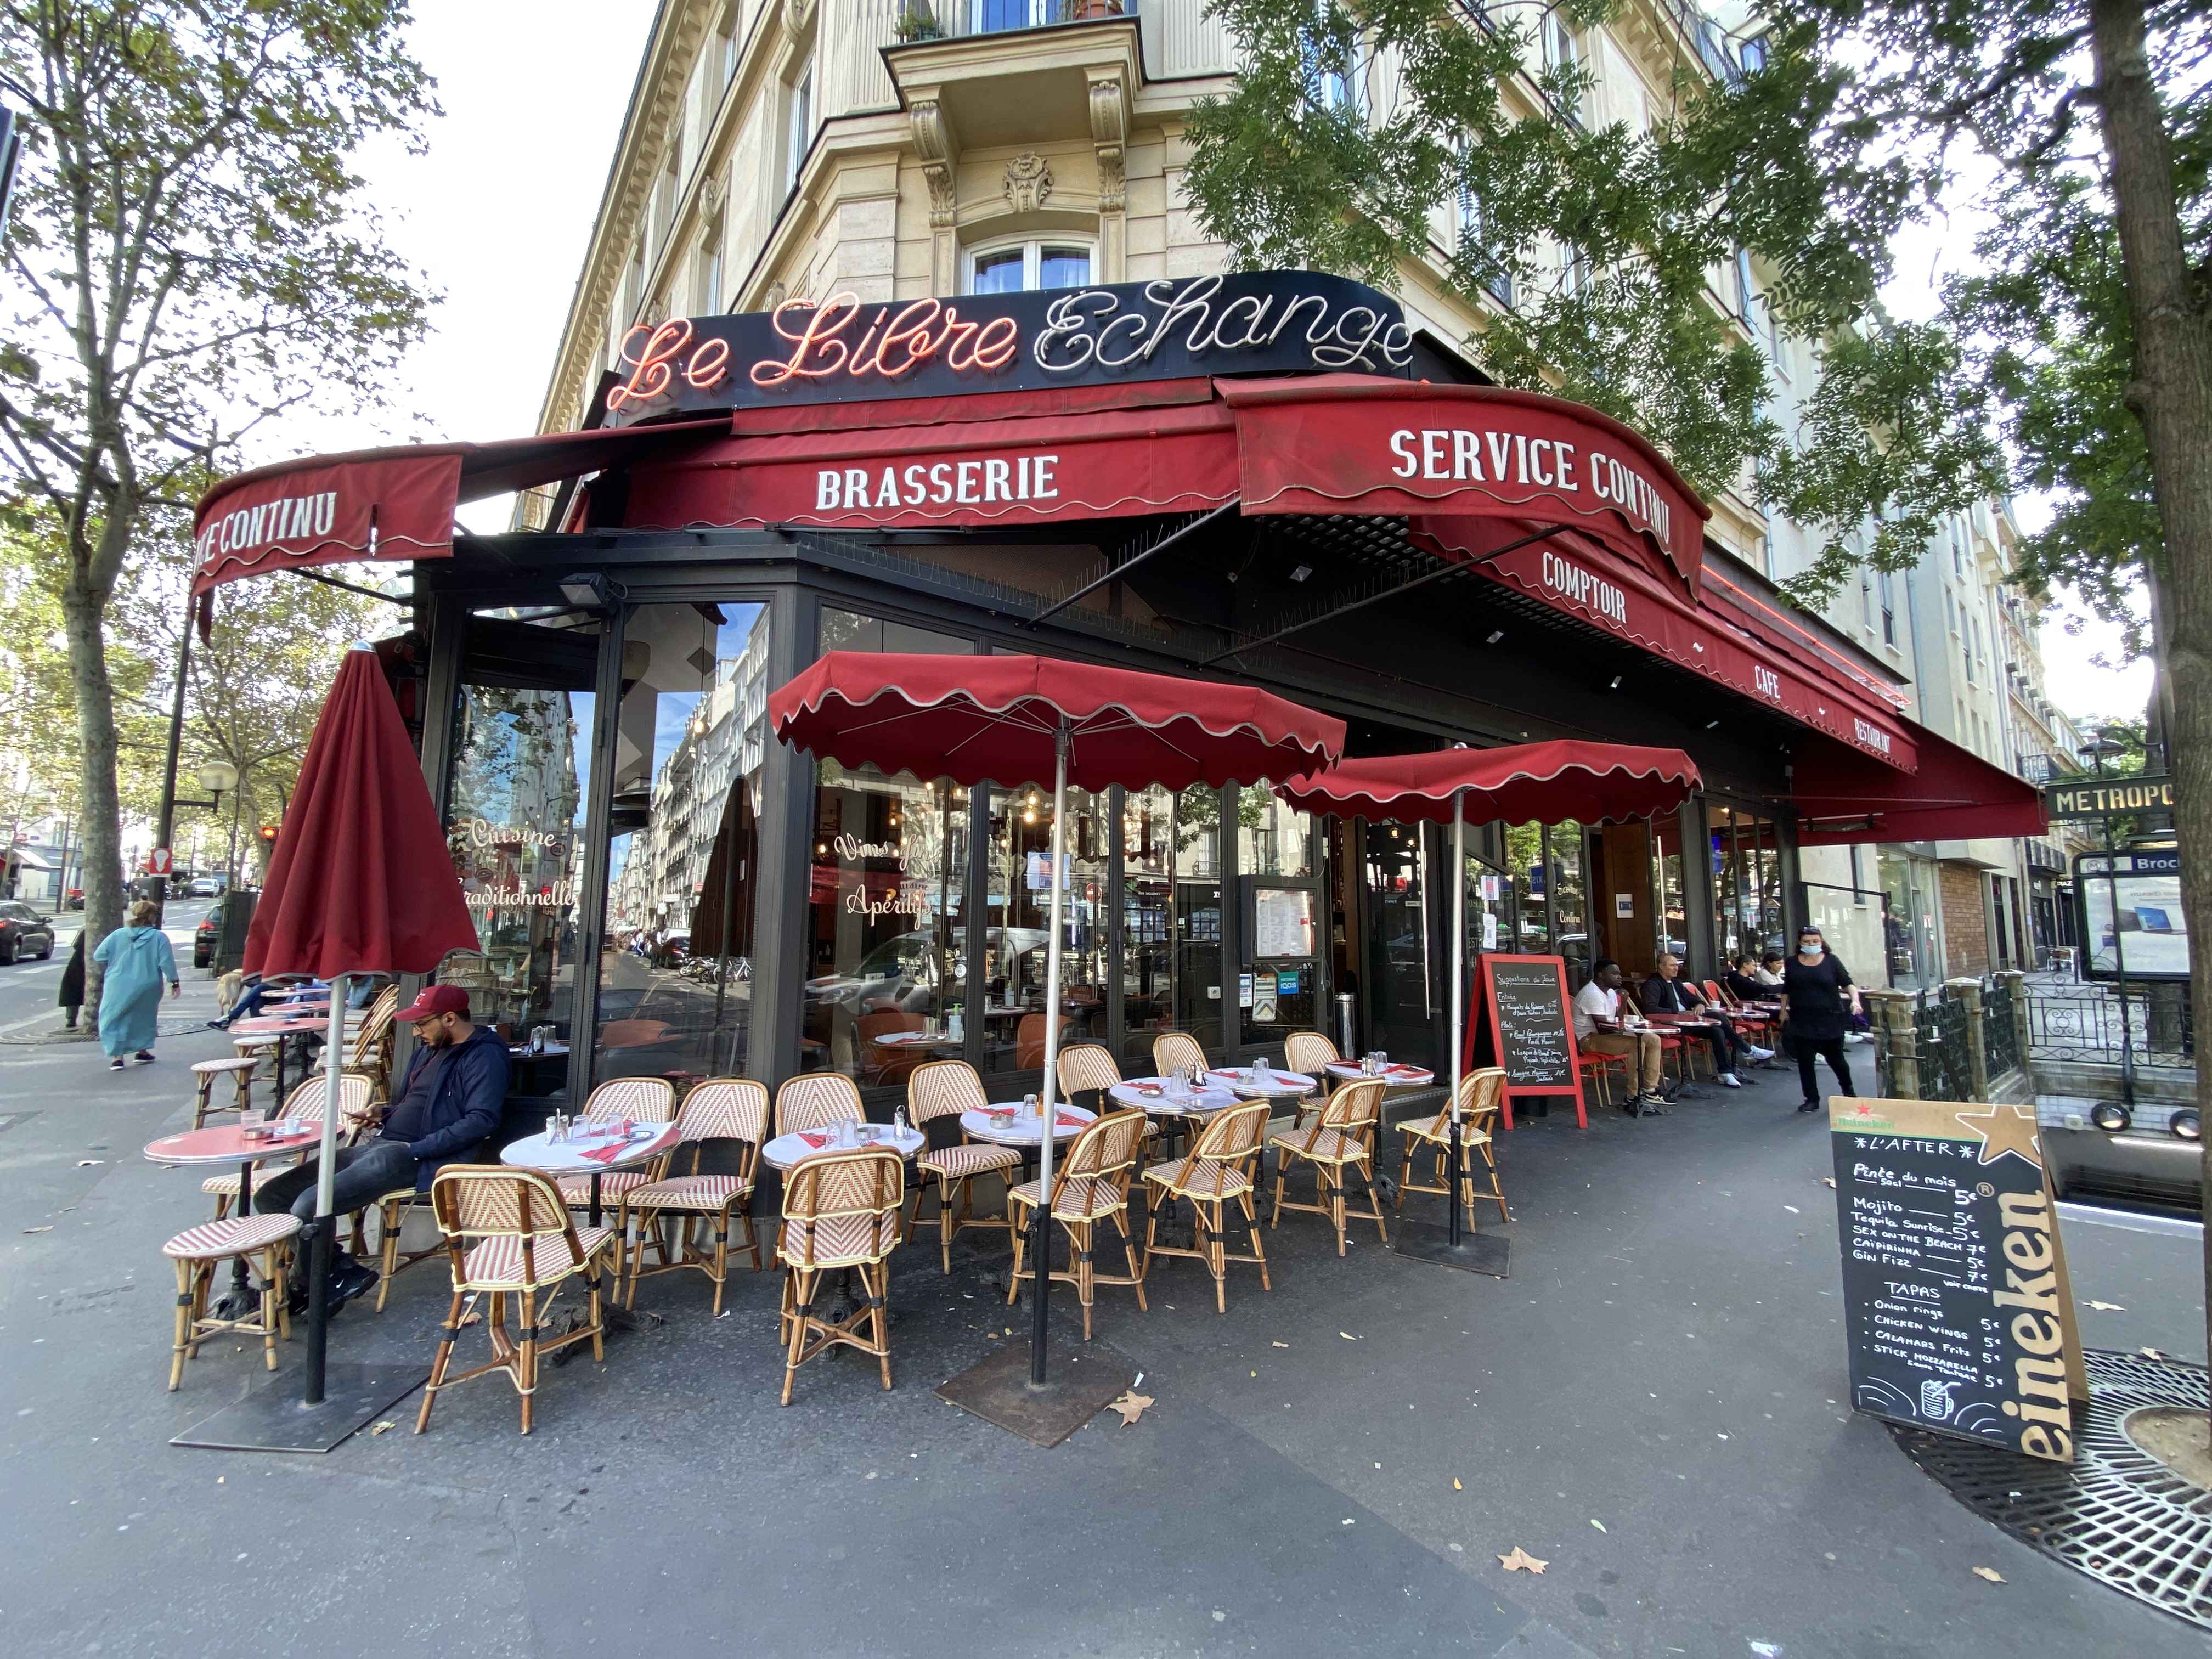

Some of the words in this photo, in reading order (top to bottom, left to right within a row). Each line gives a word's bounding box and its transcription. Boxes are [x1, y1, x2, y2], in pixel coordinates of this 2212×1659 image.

[606, 317, 730, 411] Le
[750, 291, 1019, 387] Libre
[1034, 274, 1414, 371] Echange
[815, 455, 1059, 510] BRASSERIE
[1390, 429, 1579, 492] SERVICE
[1590, 452, 1669, 545] CONTINU
[219, 492, 337, 555] CONTINU
[1543, 551, 1627, 624] COMPTOIR
[1754, 664, 1781, 699] CAFE
[470, 818, 558, 848] Cuisine
[834, 832, 889, 861] Vins
[2137, 857, 2181, 870] Broc
[458, 878, 575, 906] raditionnelle
[1853, 1163, 1895, 1180] Pinte
[1901, 1171, 1918, 1182] du
[1925, 1176, 1956, 1187] mois
[1853, 1196, 1903, 1215] Mojito
[1953, 1211, 1976, 1226] 5€
[1954, 1189, 1978, 1205] 5€
[1850, 1211, 1899, 1227] Tequila
[1903, 1219, 1944, 1233] Sunrise
[1952, 1227, 1980, 1241] 5€
[1852, 1224, 1877, 1236] SEX
[1882, 1231, 1897, 1239] ON
[1897, 1233, 1920, 1244] THE
[1924, 1236, 1962, 1251] BEACH
[1966, 1244, 1987, 1256] 7€
[1966, 1256, 1986, 1269] 5€
[1967, 1270, 1988, 1283] 7€
[1883, 1281, 1941, 1299] TAPAS
[1874, 1299, 1908, 1312] Onion
[1912, 1305, 1944, 1321] rings
[1980, 1317, 2000, 1331] 5€
[1875, 1330, 1936, 1351] CALAMARS
[1982, 1352, 2001, 1364] 5€
[1984, 1336, 2001, 1348] 5€
[1914, 1352, 1978, 1374] MOZZARELLA
[1984, 1374, 2004, 1389] 5€
